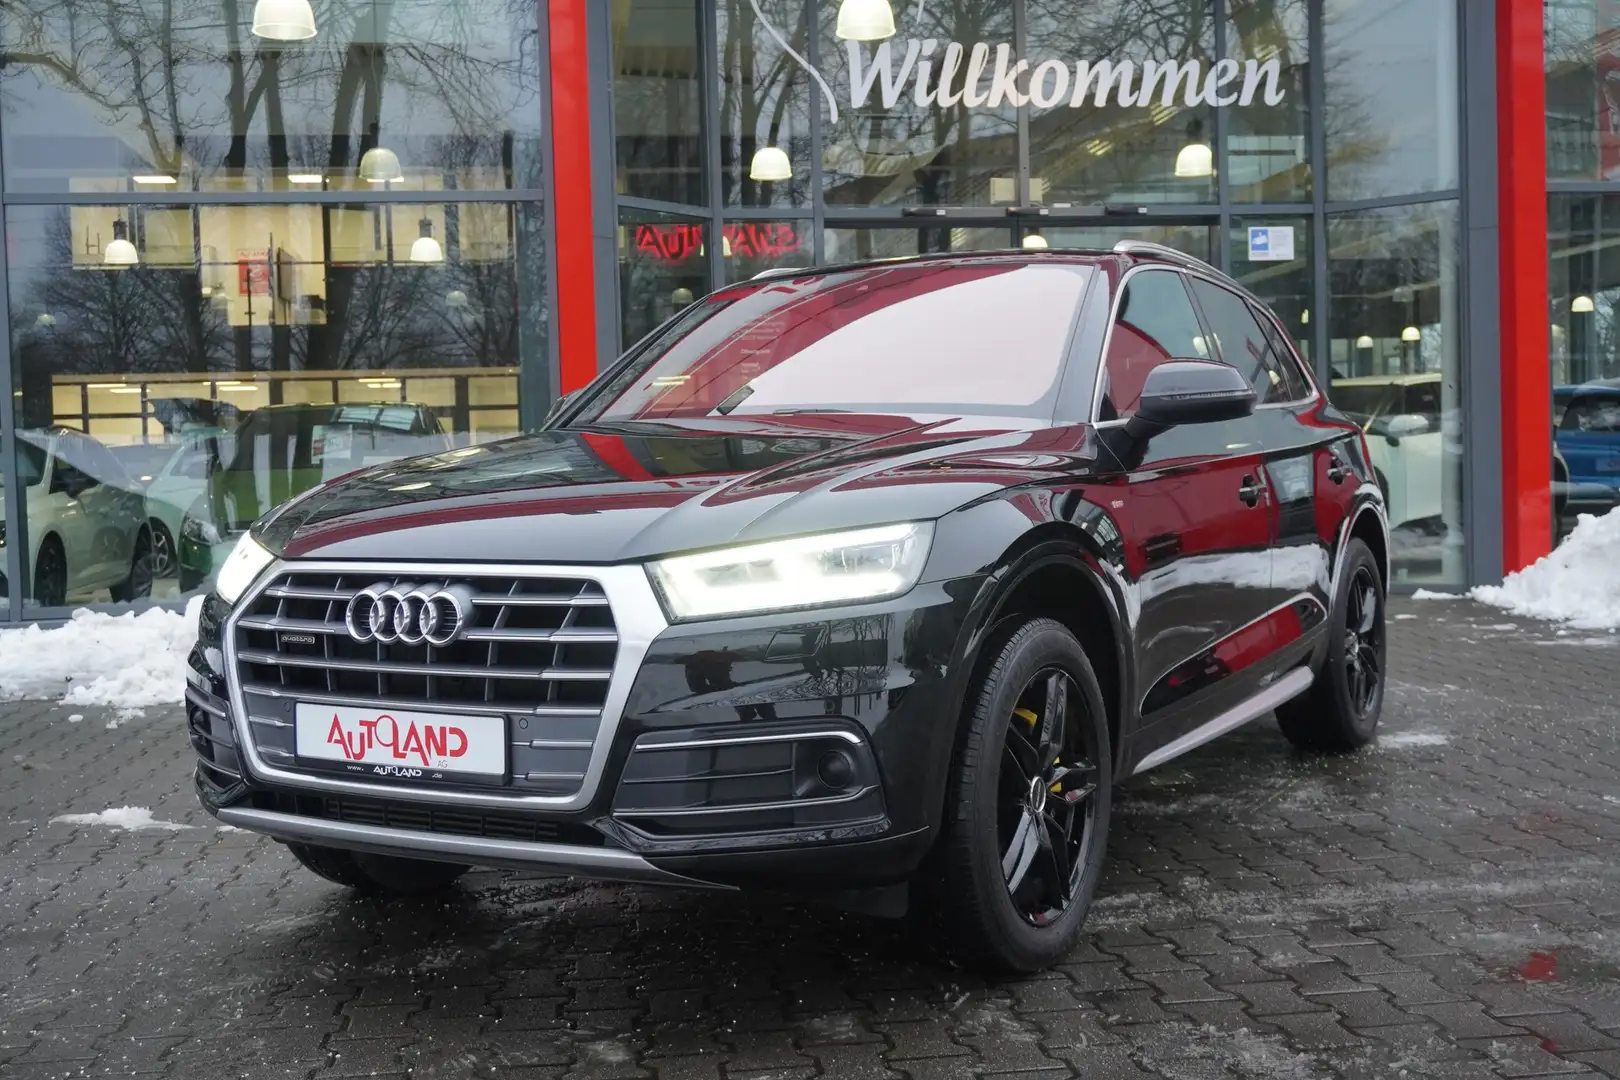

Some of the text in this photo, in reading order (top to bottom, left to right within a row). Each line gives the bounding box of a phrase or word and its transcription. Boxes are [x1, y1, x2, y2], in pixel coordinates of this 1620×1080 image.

[846, 38, 1286, 108] Willkommen
[281, 635, 314, 643] quattro
[327, 713, 468, 767] AUTOLAND
[373, 765, 422, 778] AUTOLAND
